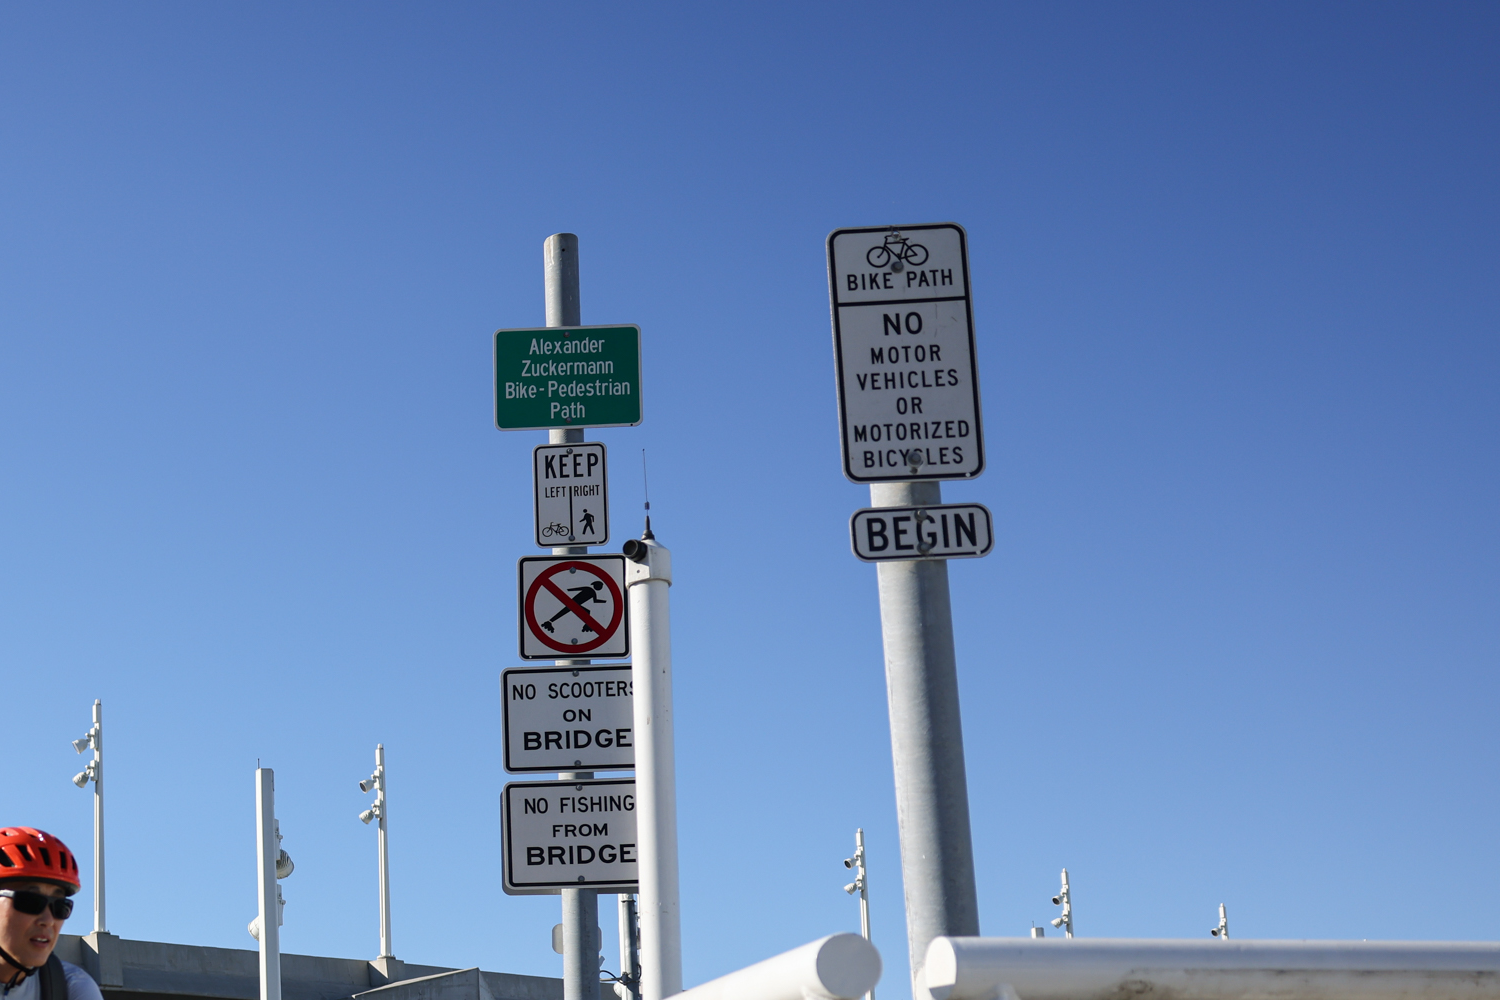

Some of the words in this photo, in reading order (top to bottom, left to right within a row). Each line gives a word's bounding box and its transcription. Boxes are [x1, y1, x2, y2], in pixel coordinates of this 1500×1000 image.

[847, 272, 894, 291] BIKE
[906, 268, 953, 288] PATH
[882, 311, 923, 336] NO
[529, 337, 606, 355] Alexander
[870, 344, 941, 365] MOTOR
[521, 360, 614, 377] Zuckermann
[856, 368, 959, 391] VEHICLES
[550, 402, 586, 420] Path
[896, 396, 923, 415] OR
[854, 420, 970, 443] MOTORIZED
[544, 452, 599, 479] KEEP
[545, 486, 566, 498] LEFT
[573, 484, 600, 497] RIGHT
[866, 512, 978, 552] BEGIN
[512, 683, 536, 700] NO
[562, 708, 592, 722] ON
[523, 728, 633, 751] BRIDGE
[524, 797, 548, 814] NO
[560, 794, 635, 813] FISHING
[552, 823, 609, 837] FROM
[526, 843, 637, 866] BRIDGE
